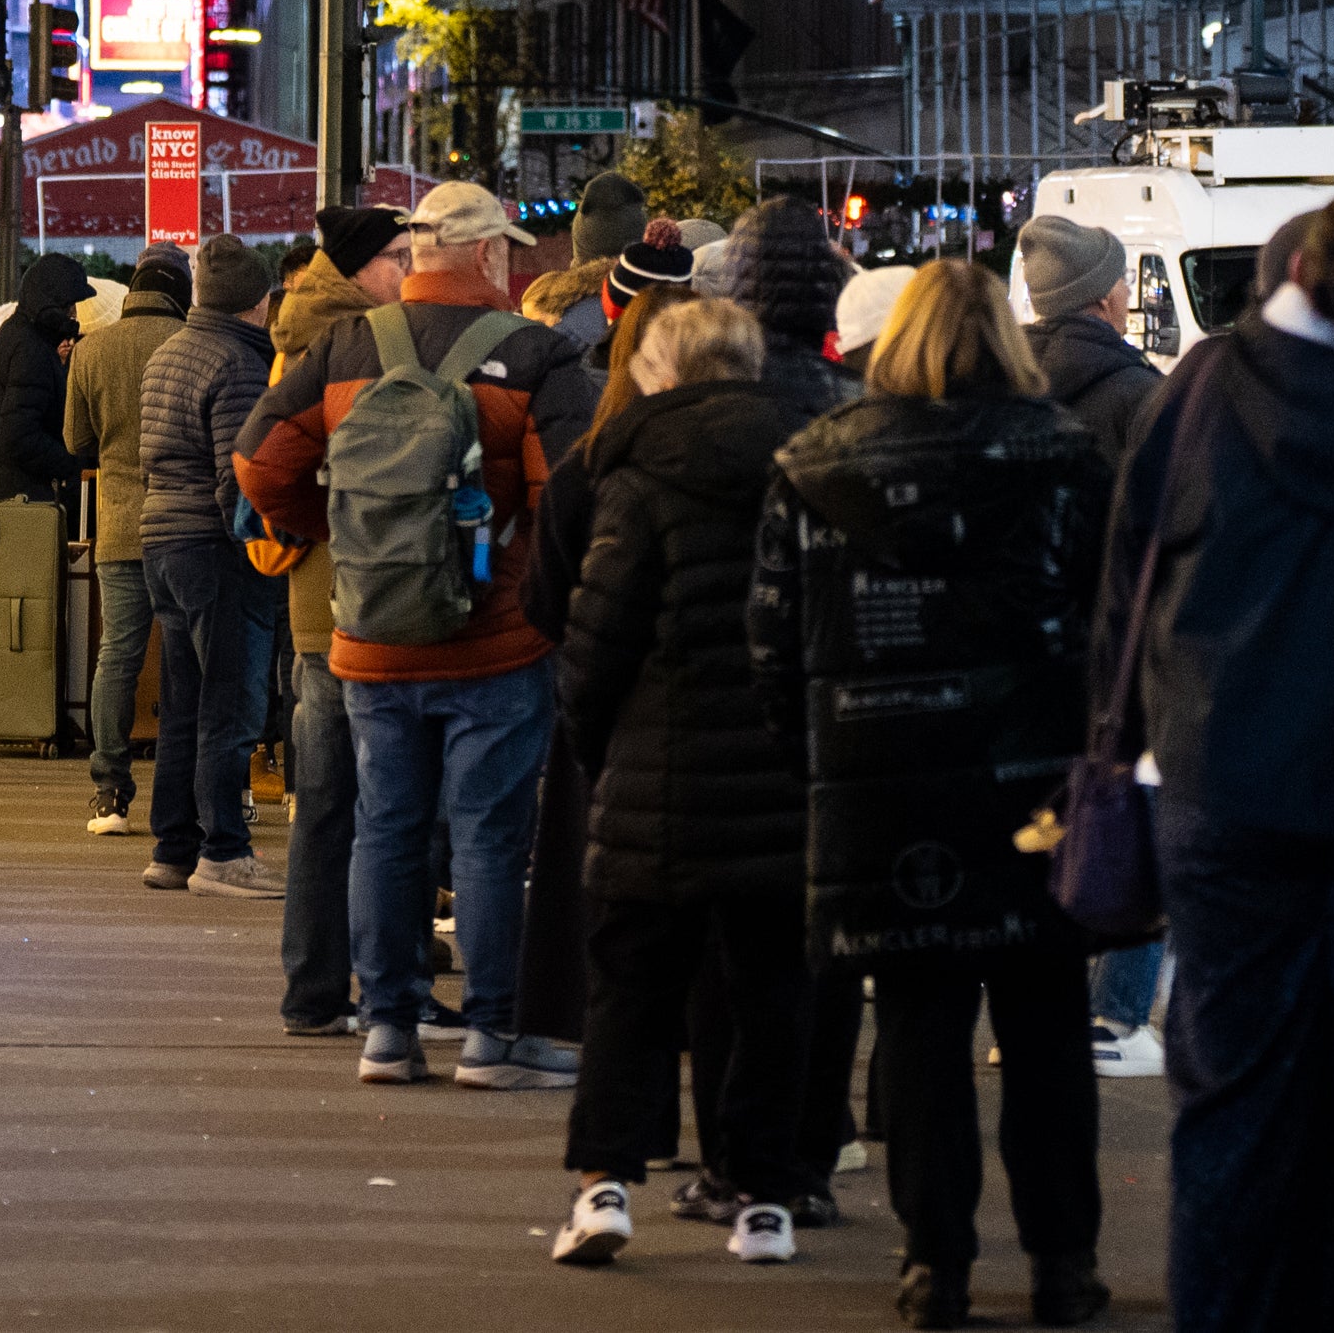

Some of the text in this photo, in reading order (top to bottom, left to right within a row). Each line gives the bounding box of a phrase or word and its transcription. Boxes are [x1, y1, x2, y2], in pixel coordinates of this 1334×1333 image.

[151, 126, 196, 140] know
[151, 142, 196, 157] NYC
[23, 137, 118, 178] Herald
[240, 138, 299, 170] Bar
[171, 161, 196, 169] Street
[151, 169, 196, 179] district
[151, 229, 196, 242] Macy's
